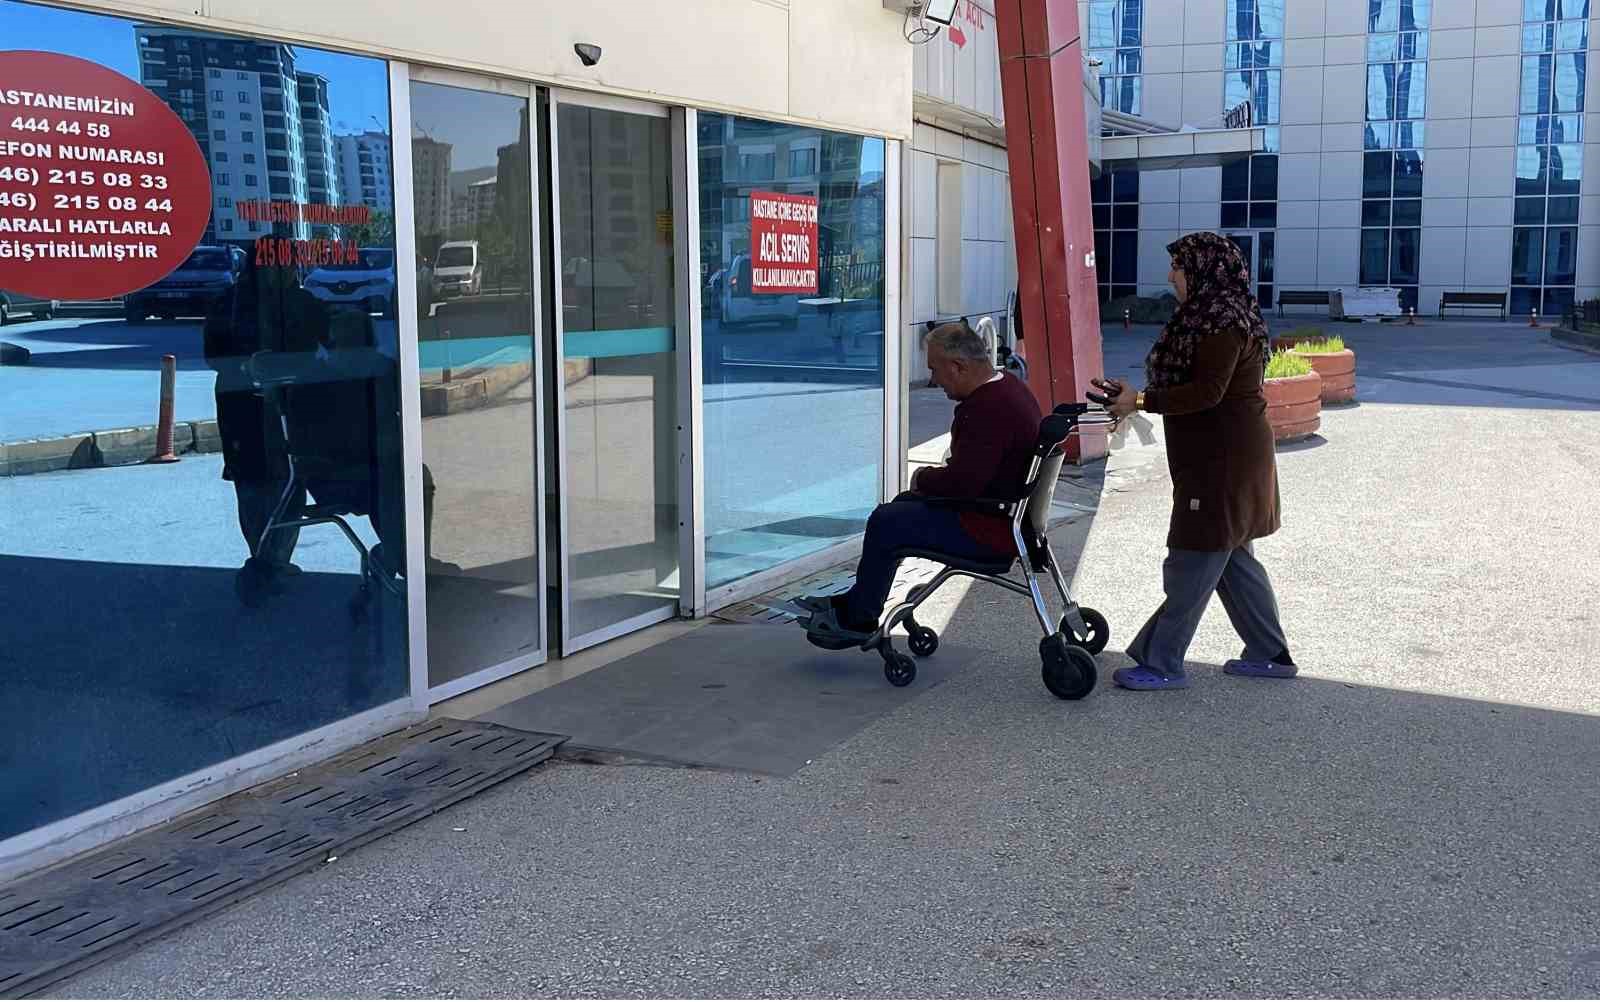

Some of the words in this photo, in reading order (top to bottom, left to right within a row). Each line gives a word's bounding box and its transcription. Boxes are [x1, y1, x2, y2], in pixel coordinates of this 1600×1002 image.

[11, 117, 50, 133] 444
[56, 120, 81, 135] 44
[87, 123, 110, 138] 58
[59, 145, 164, 166] NUMARASI
[0, 166, 39, 186] 46)
[48, 169, 95, 185] 215
[103, 172, 132, 187] 08
[140, 174, 168, 190] 33
[0, 192, 37, 211] 46)
[54, 194, 100, 210] 215
[108, 196, 137, 211] 08
[145, 198, 173, 213] 44
[753, 198, 777, 219] HASTANE
[792, 199, 807, 228] GEÇİŞ
[0, 218, 61, 233] ARALI
[69, 219, 172, 236] HATLARLA
[0, 240, 158, 262] ĞİŞTİRİLMİŞTİR
[255, 238, 276, 266] 215
[760, 223, 780, 262] ACİL
[781, 226, 810, 264] SERVİS
[752, 267, 816, 288] KULLANILMAYACAKTIR
